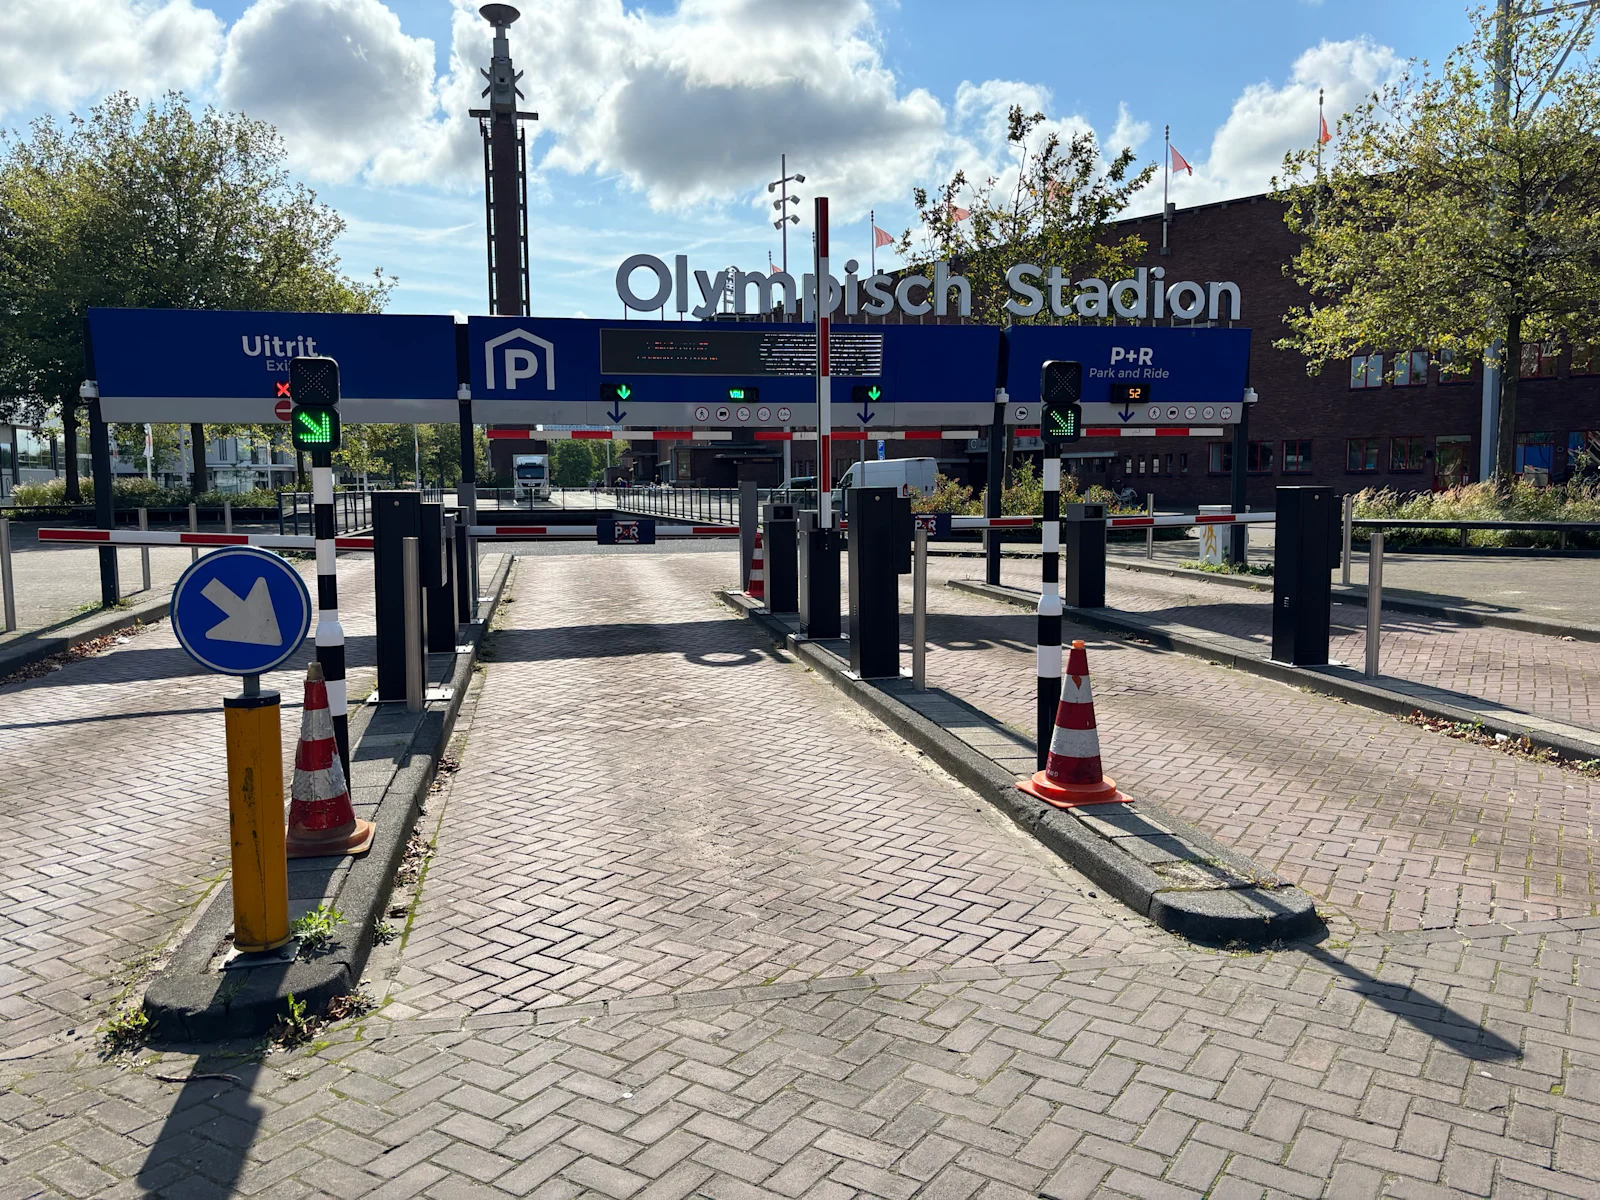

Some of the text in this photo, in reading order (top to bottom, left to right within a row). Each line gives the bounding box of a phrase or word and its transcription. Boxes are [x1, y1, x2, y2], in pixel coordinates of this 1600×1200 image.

[615, 253, 1241, 322] Olympisch Stadion
[241, 334, 319, 358] Uitrit
[1110, 346, 1154, 366] P+R
[266, 359, 291, 371] Exi
[504, 348, 539, 390] P
[1089, 368, 1170, 379] Park and Ride
[1128, 388, 1141, 399] 52
